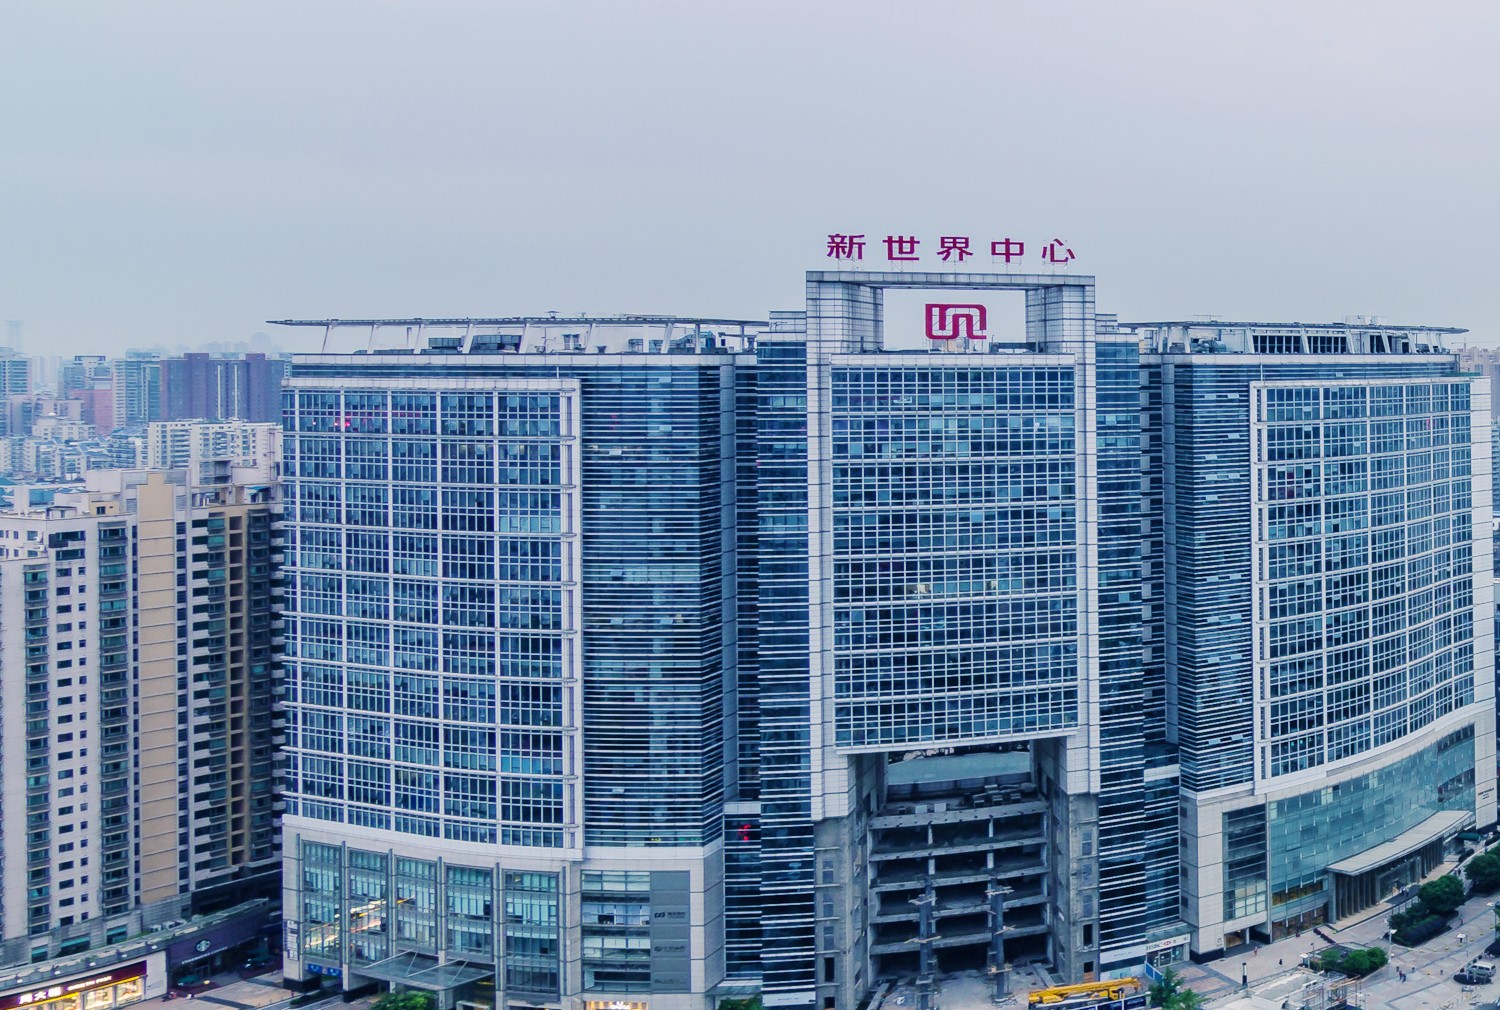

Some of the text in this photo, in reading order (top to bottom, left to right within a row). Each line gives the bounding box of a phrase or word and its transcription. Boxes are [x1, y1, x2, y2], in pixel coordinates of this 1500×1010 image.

[827, 233, 1076, 263] 新世界中心
